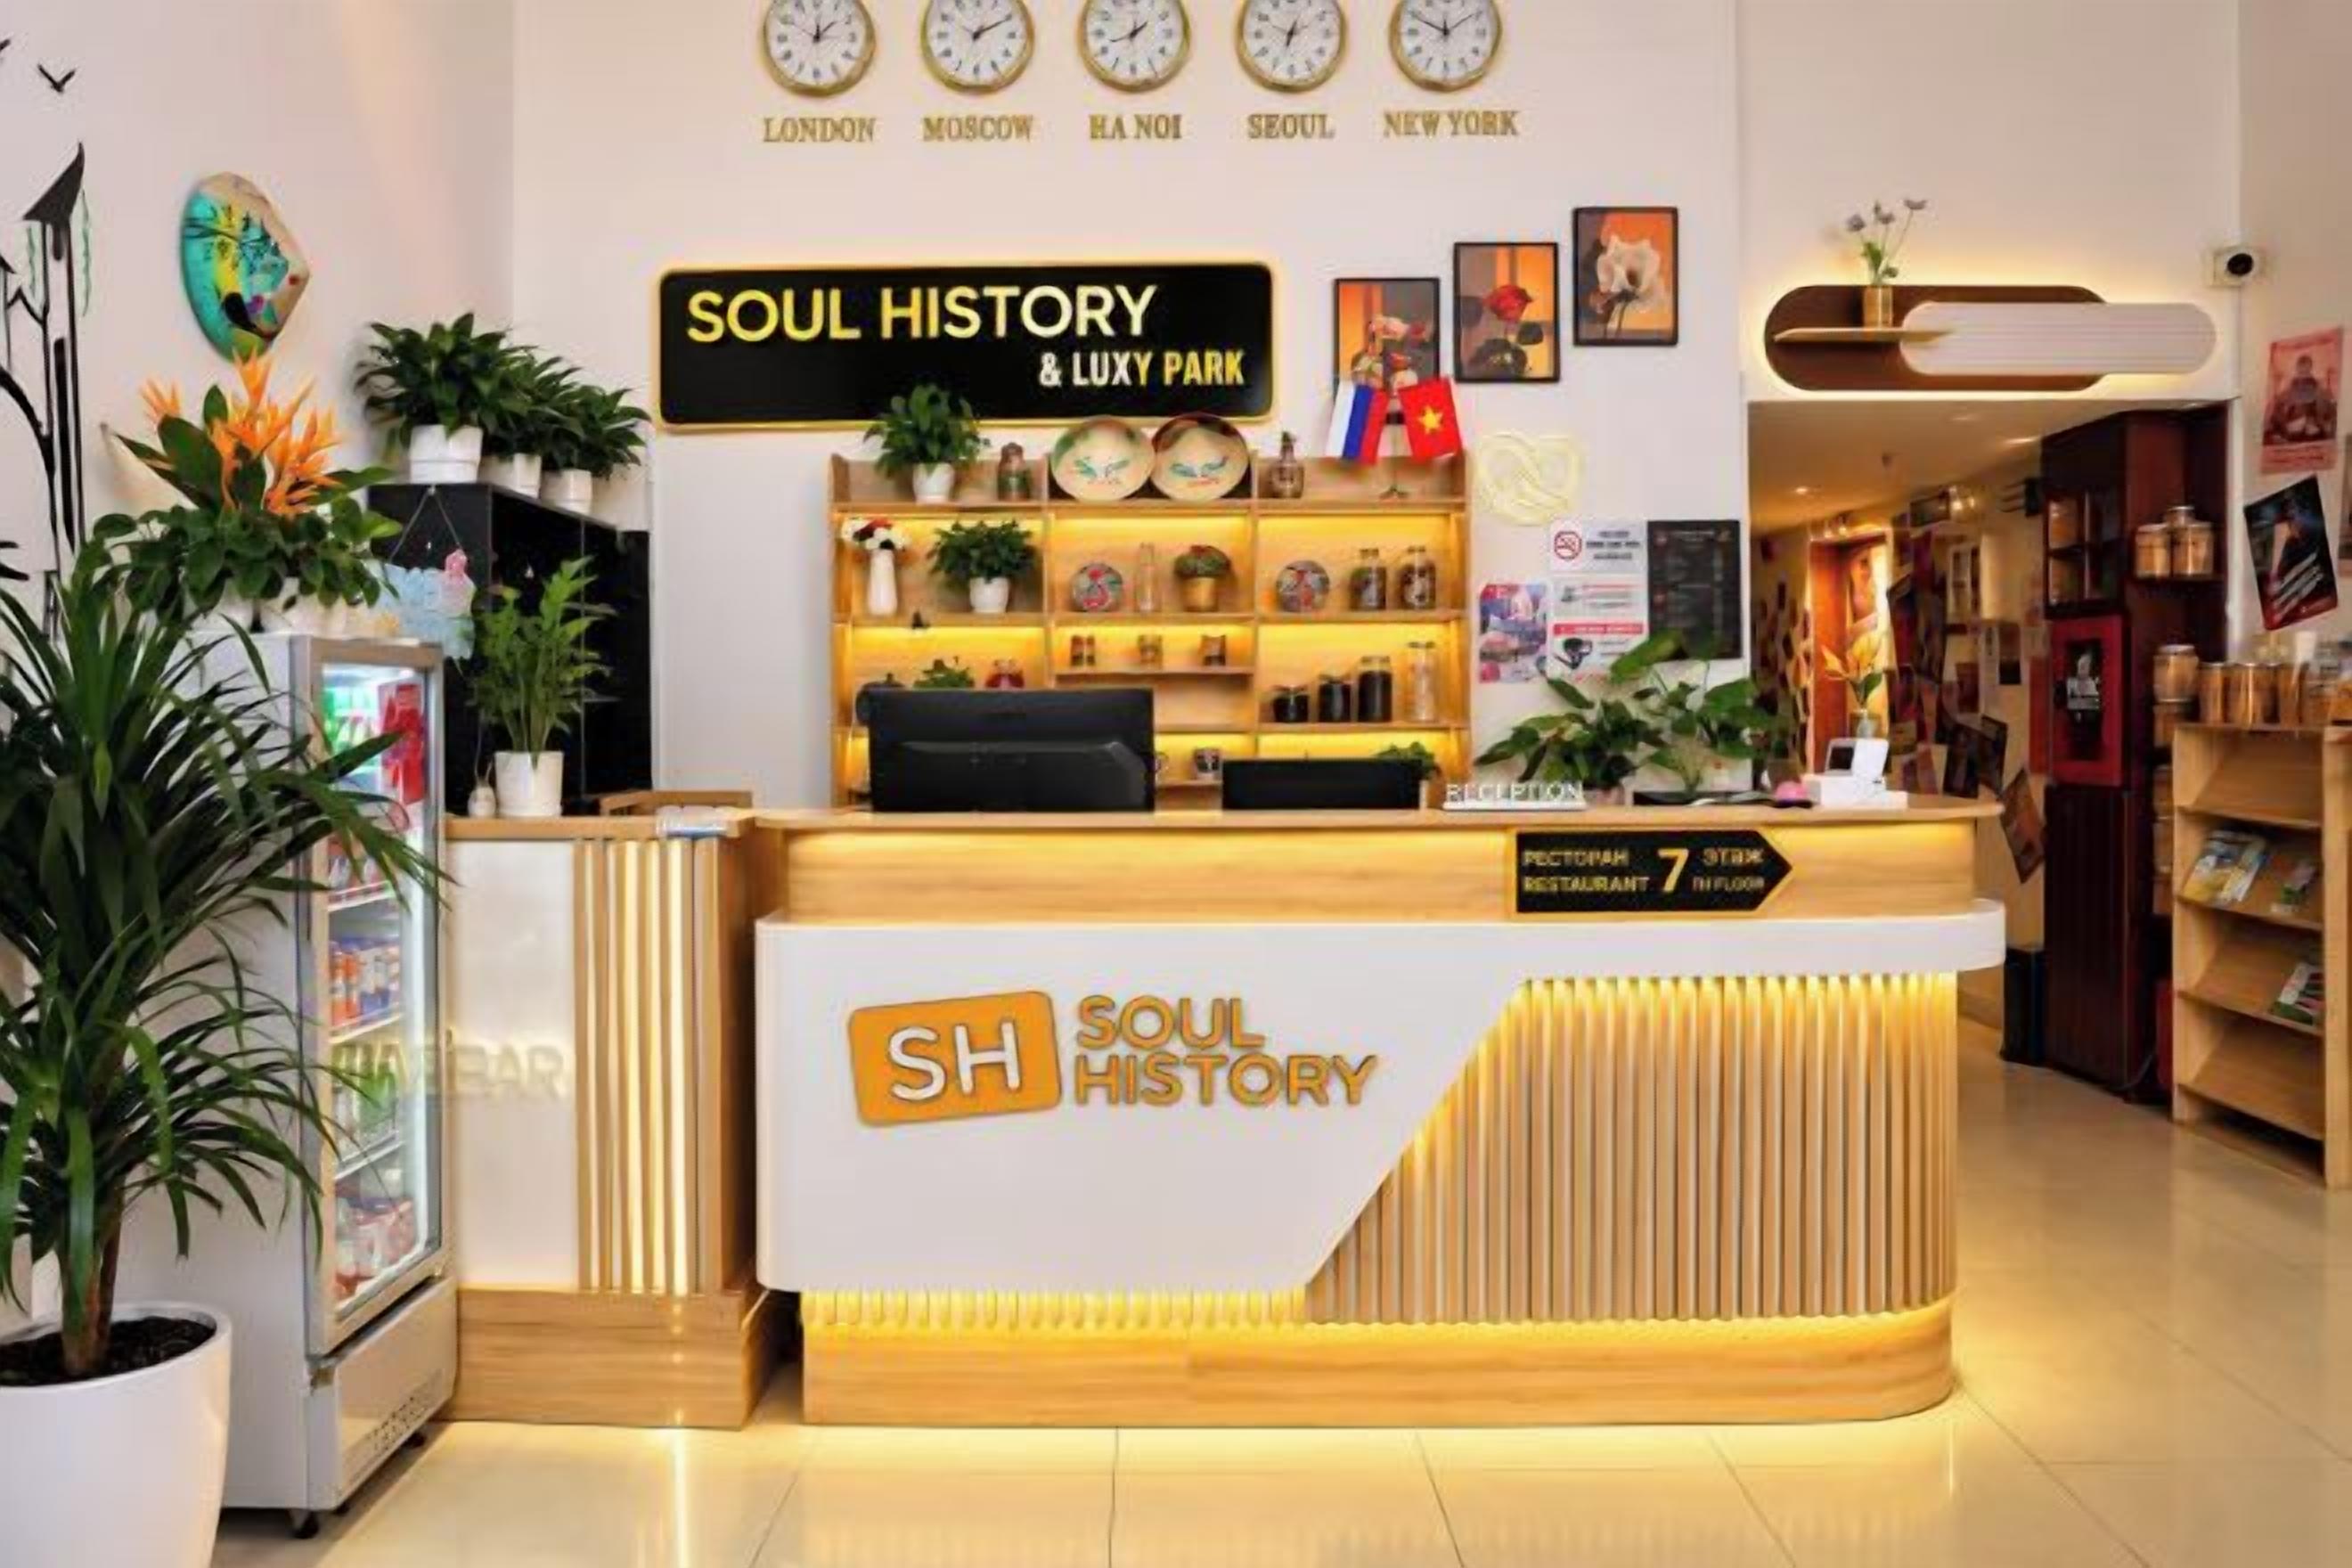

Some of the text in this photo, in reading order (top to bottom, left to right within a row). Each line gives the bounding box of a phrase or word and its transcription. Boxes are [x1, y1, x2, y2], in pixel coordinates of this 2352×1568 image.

[763, 118, 876, 143] LONDON
[923, 115, 1033, 142] MOSCOW
[1089, 114, 1183, 139] HA NOI
[1247, 114, 1335, 139] SEOUL
[1383, 110, 1520, 137] NEW YORK
[686, 283, 1158, 343] SOUL HISTORY
[1039, 350, 1245, 387] & LUXY PARK
[1523, 876, 1650, 893] RESTAURANT
[1658, 848, 1689, 893] 7
[1076, 994, 1266, 1049] SOUL
[888, 1018, 1023, 1102] SH
[1074, 1053, 1379, 1107] HISTORY
